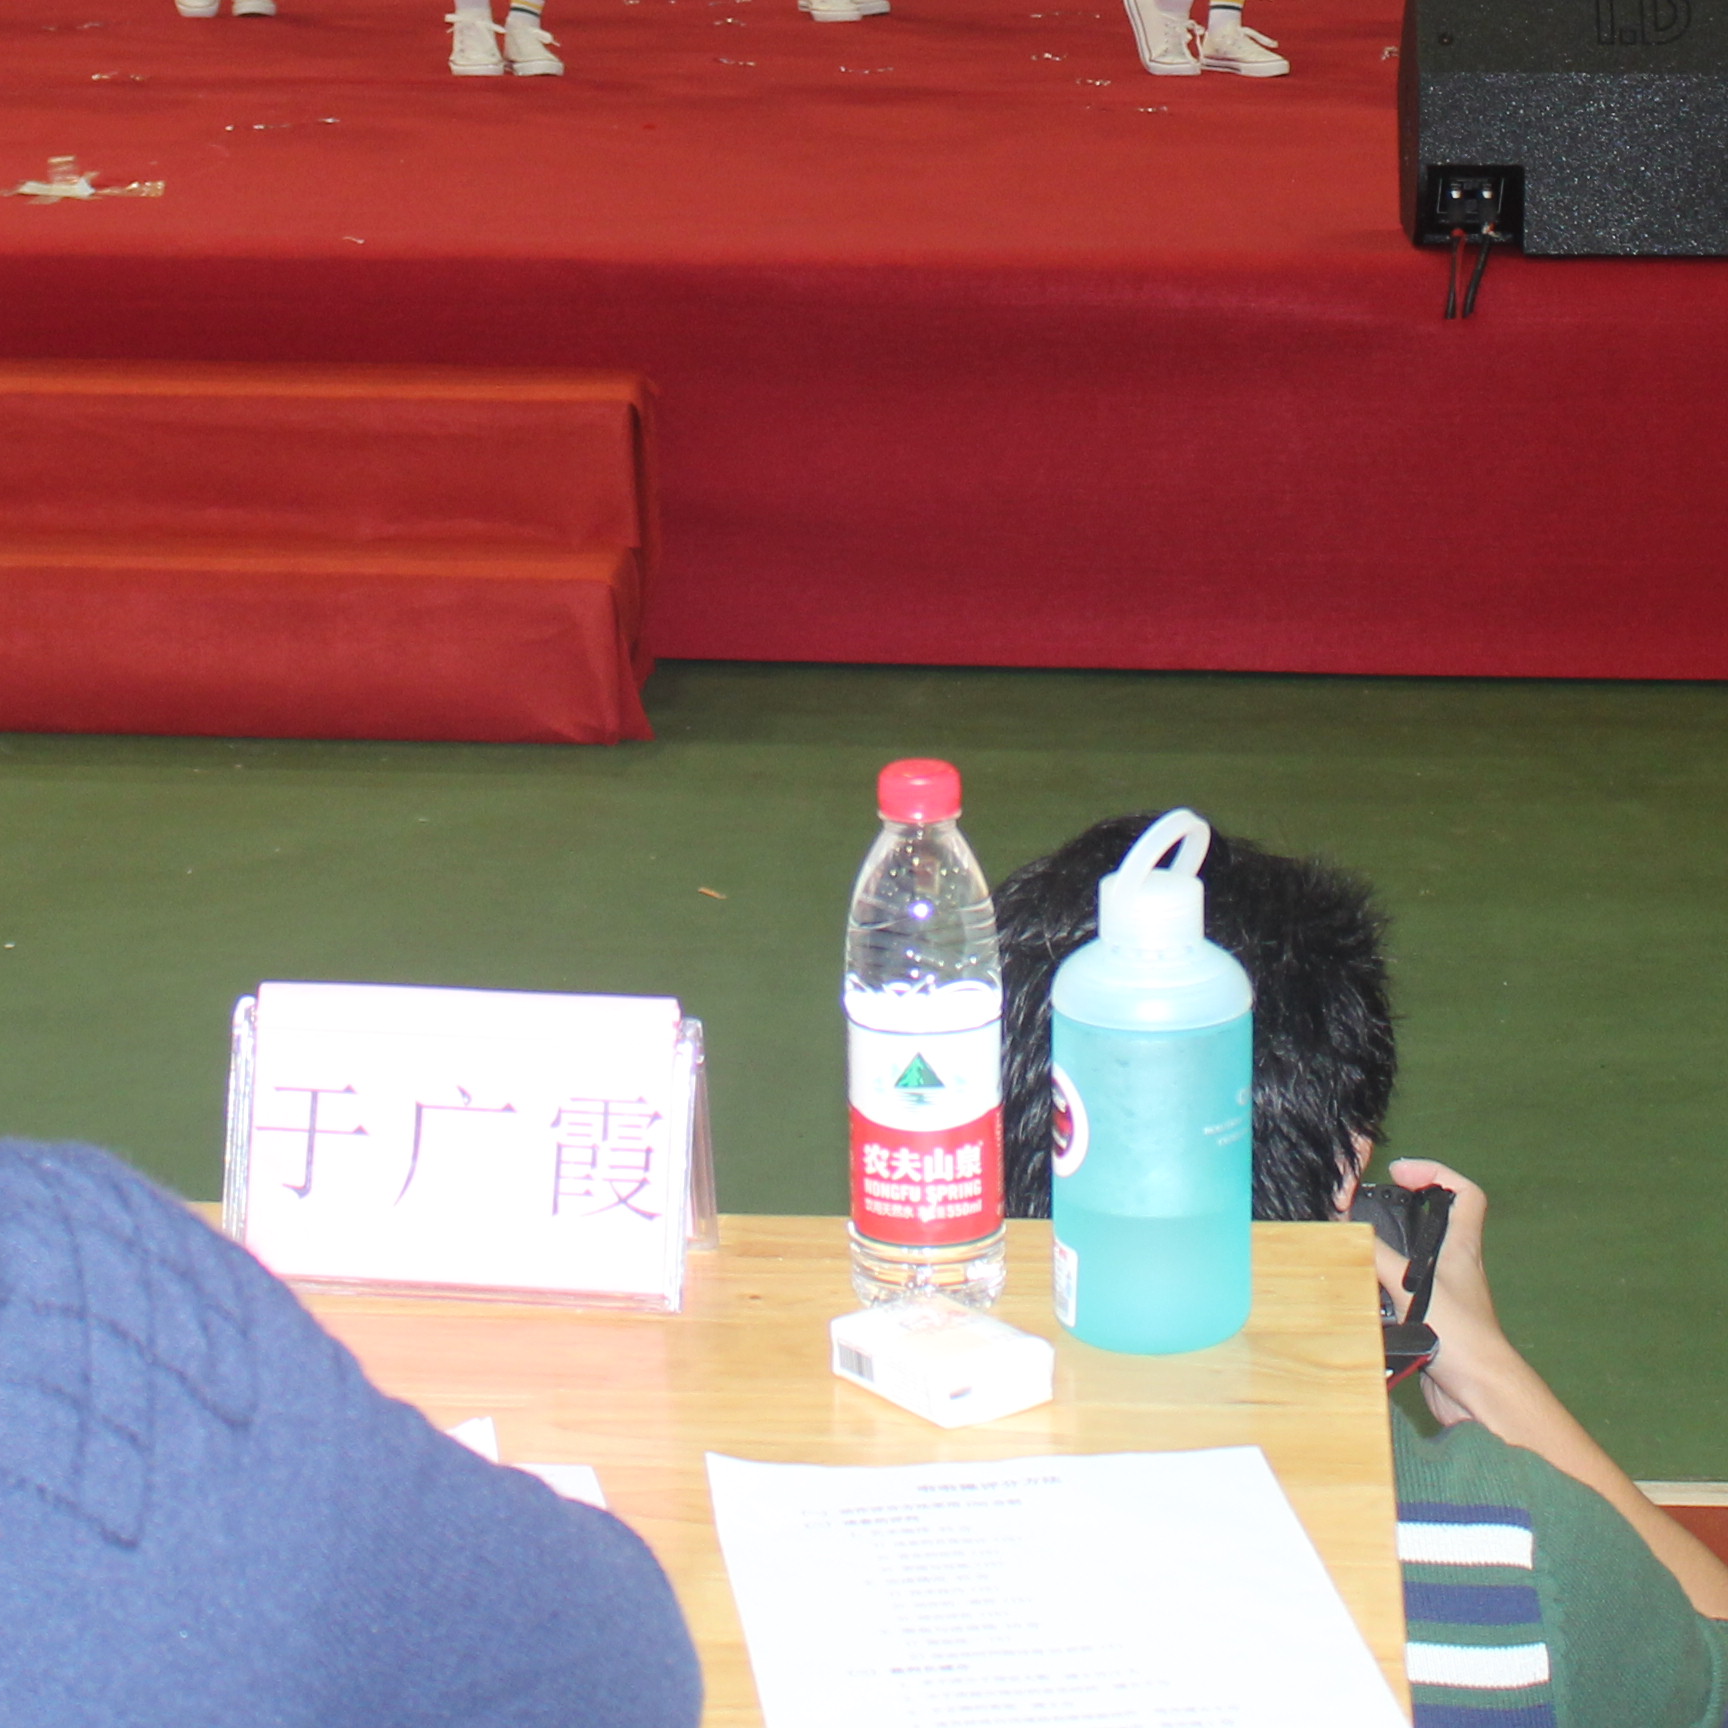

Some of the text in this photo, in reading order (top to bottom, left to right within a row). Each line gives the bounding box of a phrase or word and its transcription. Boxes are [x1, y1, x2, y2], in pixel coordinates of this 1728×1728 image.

[253, 1080, 665, 1223] 于广霞
[862, 1142, 983, 1184] 农夫山泉
[863, 1177, 983, 1204] NONGFU SPRING
